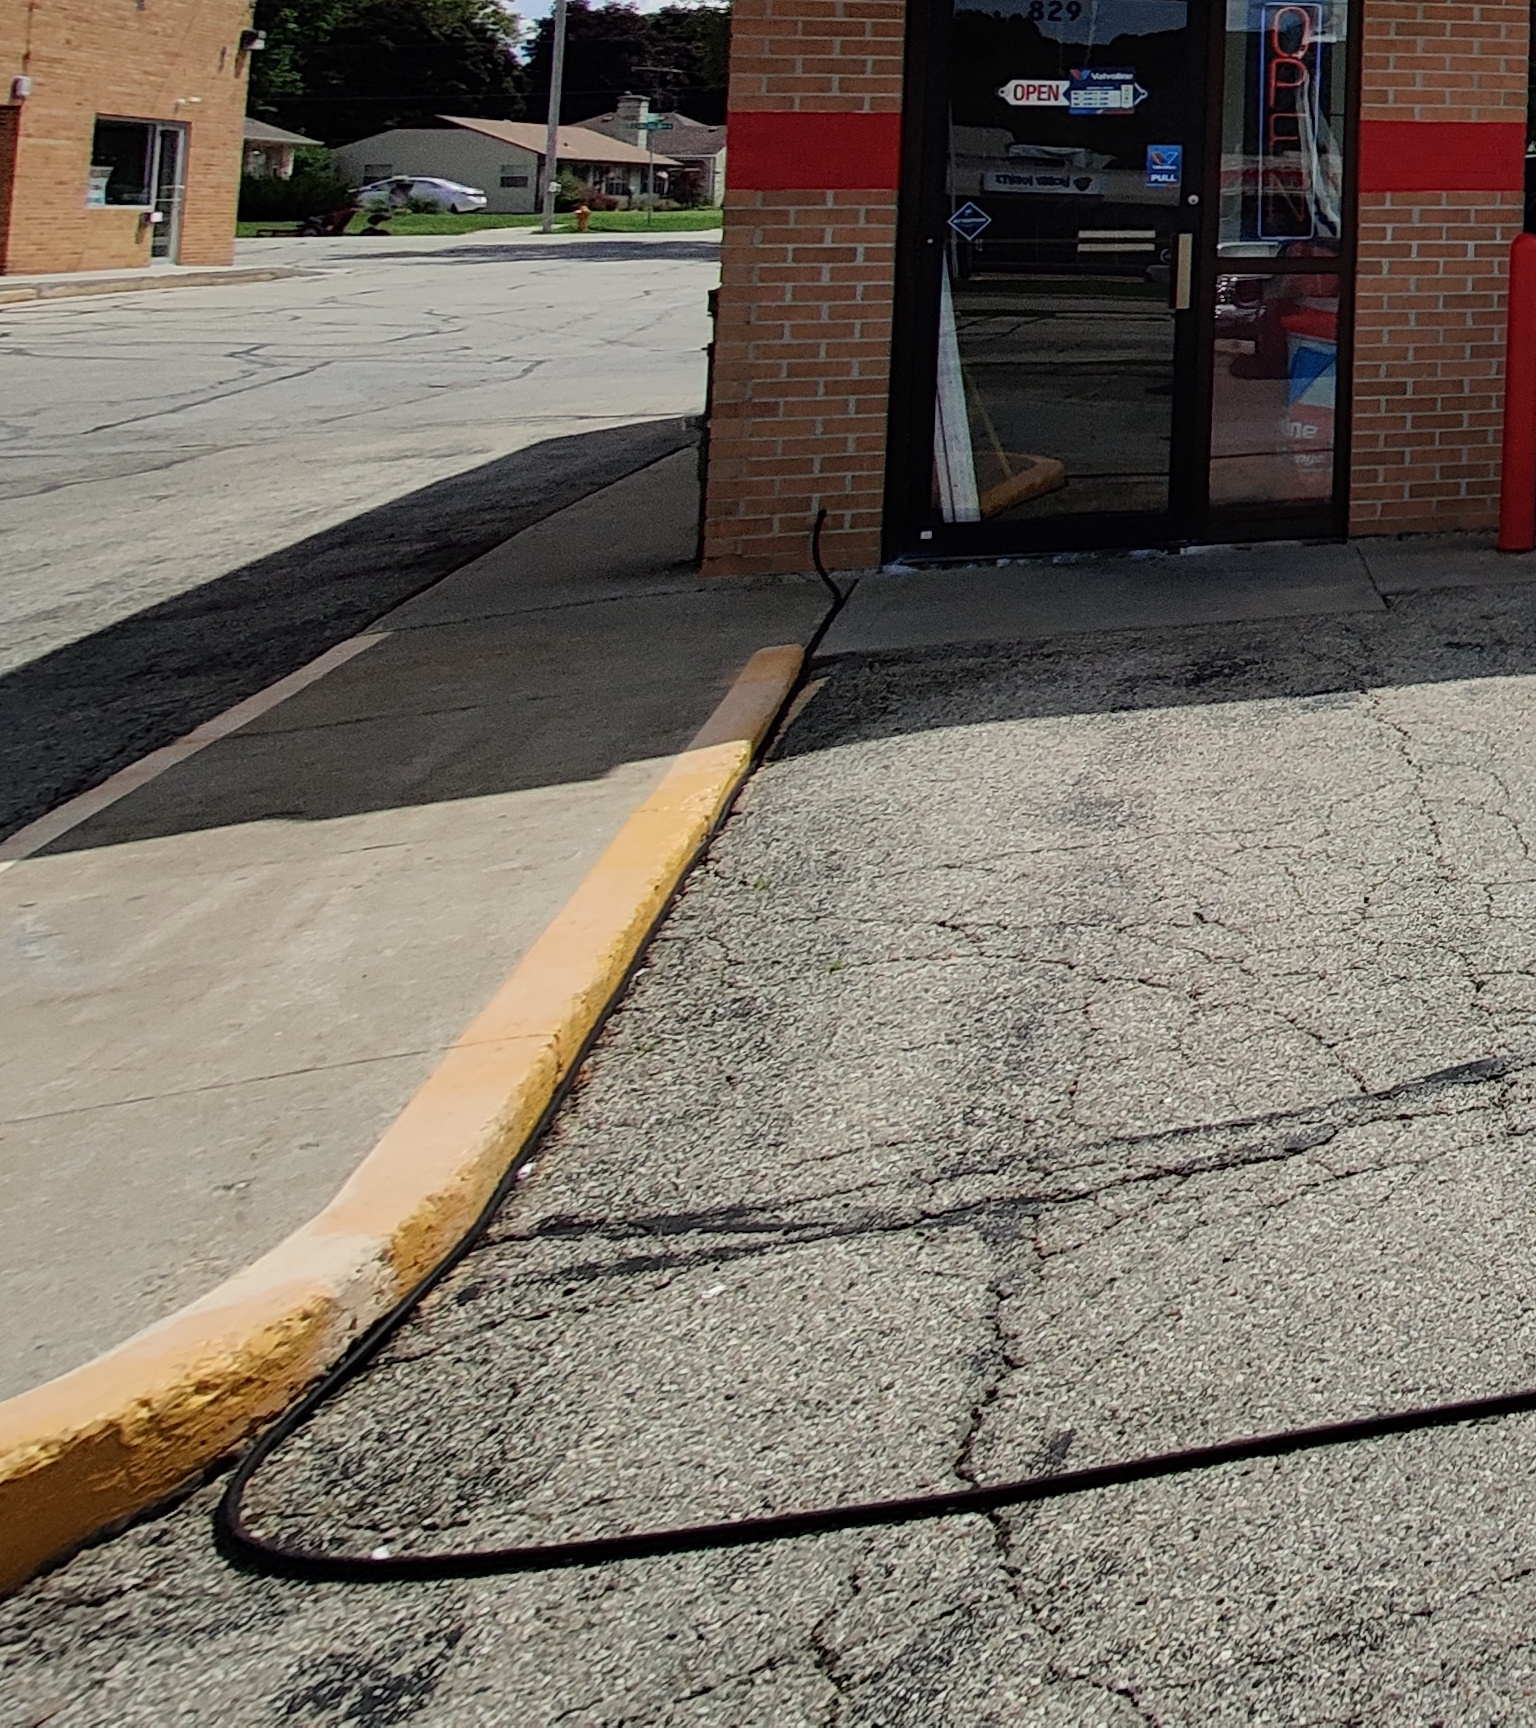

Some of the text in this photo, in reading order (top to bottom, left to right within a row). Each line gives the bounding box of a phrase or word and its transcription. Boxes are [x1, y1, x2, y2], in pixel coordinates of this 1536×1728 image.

[1029, 0, 1082, 22] 829
[1013, 83, 1060, 102] OPEN
[1150, 173, 1178, 182] PULL
